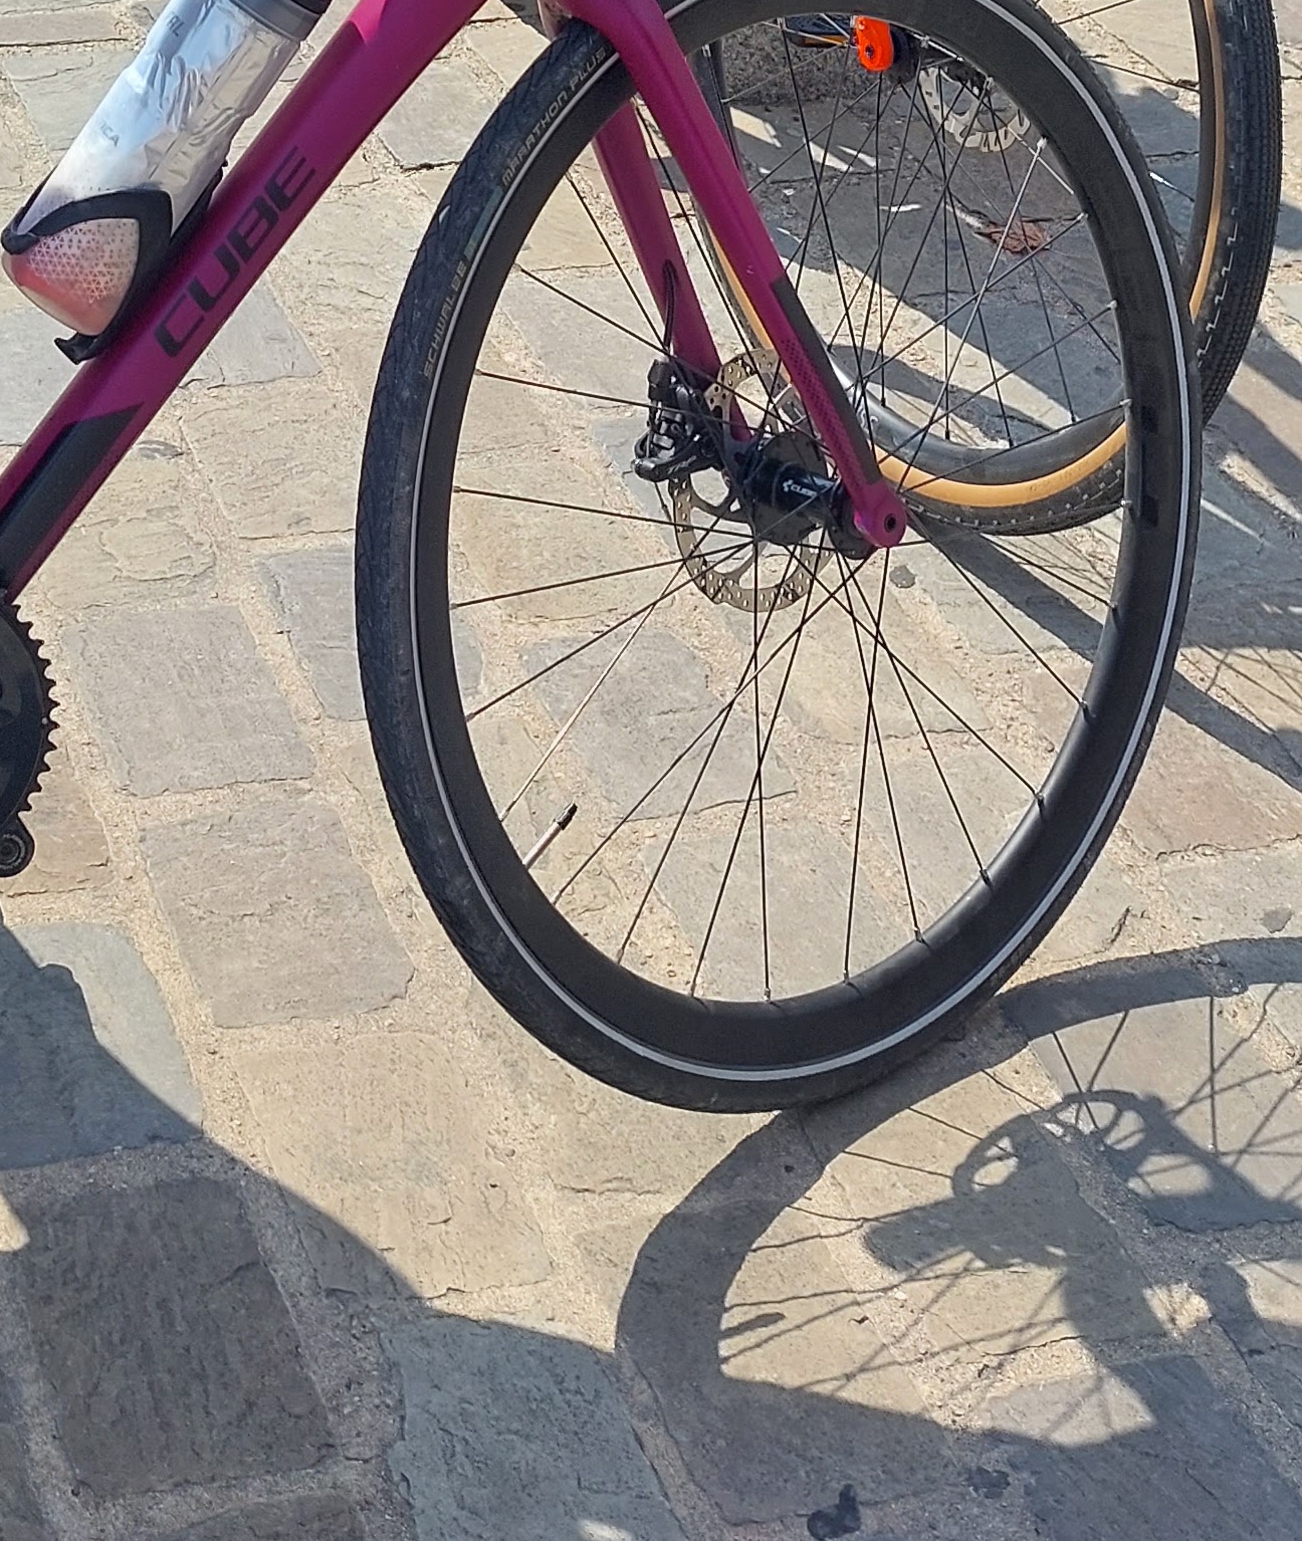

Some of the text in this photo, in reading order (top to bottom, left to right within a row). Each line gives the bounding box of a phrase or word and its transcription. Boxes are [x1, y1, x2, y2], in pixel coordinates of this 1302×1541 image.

[502, 47, 607, 186] MARATHON PLUS
[153, 145, 317, 358] CUBE
[423, 260, 468, 379] SCHWALBE
